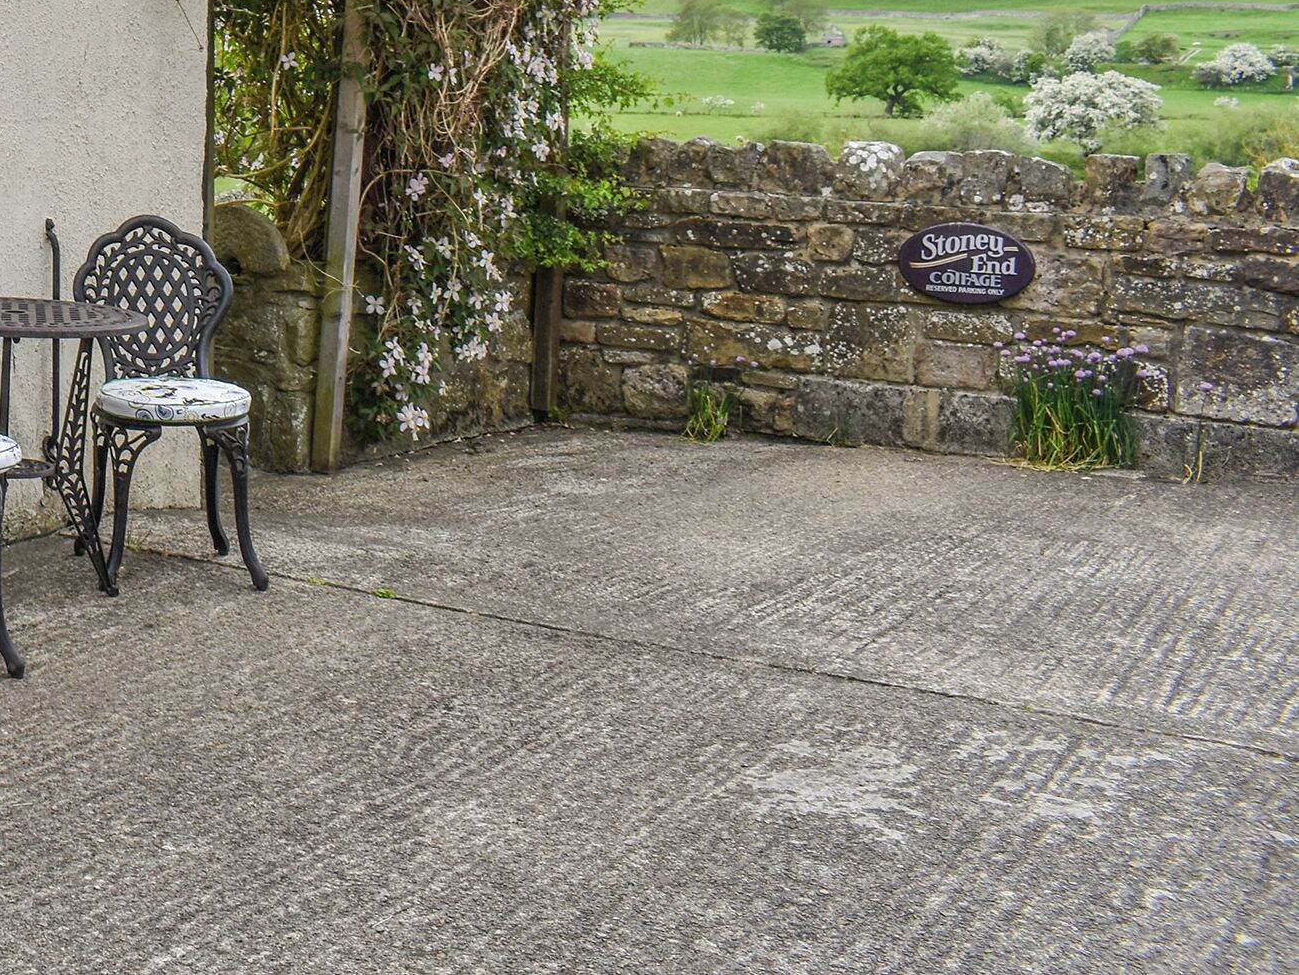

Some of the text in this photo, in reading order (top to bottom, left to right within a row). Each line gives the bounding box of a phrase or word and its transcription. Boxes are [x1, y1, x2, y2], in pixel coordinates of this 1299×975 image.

[920, 233, 1004, 261] Stoney
[969, 253, 1018, 275] End
[929, 269, 1002, 288] COTTAGE
[925, 284, 1005, 296] RESERVED PARKING ONLY
